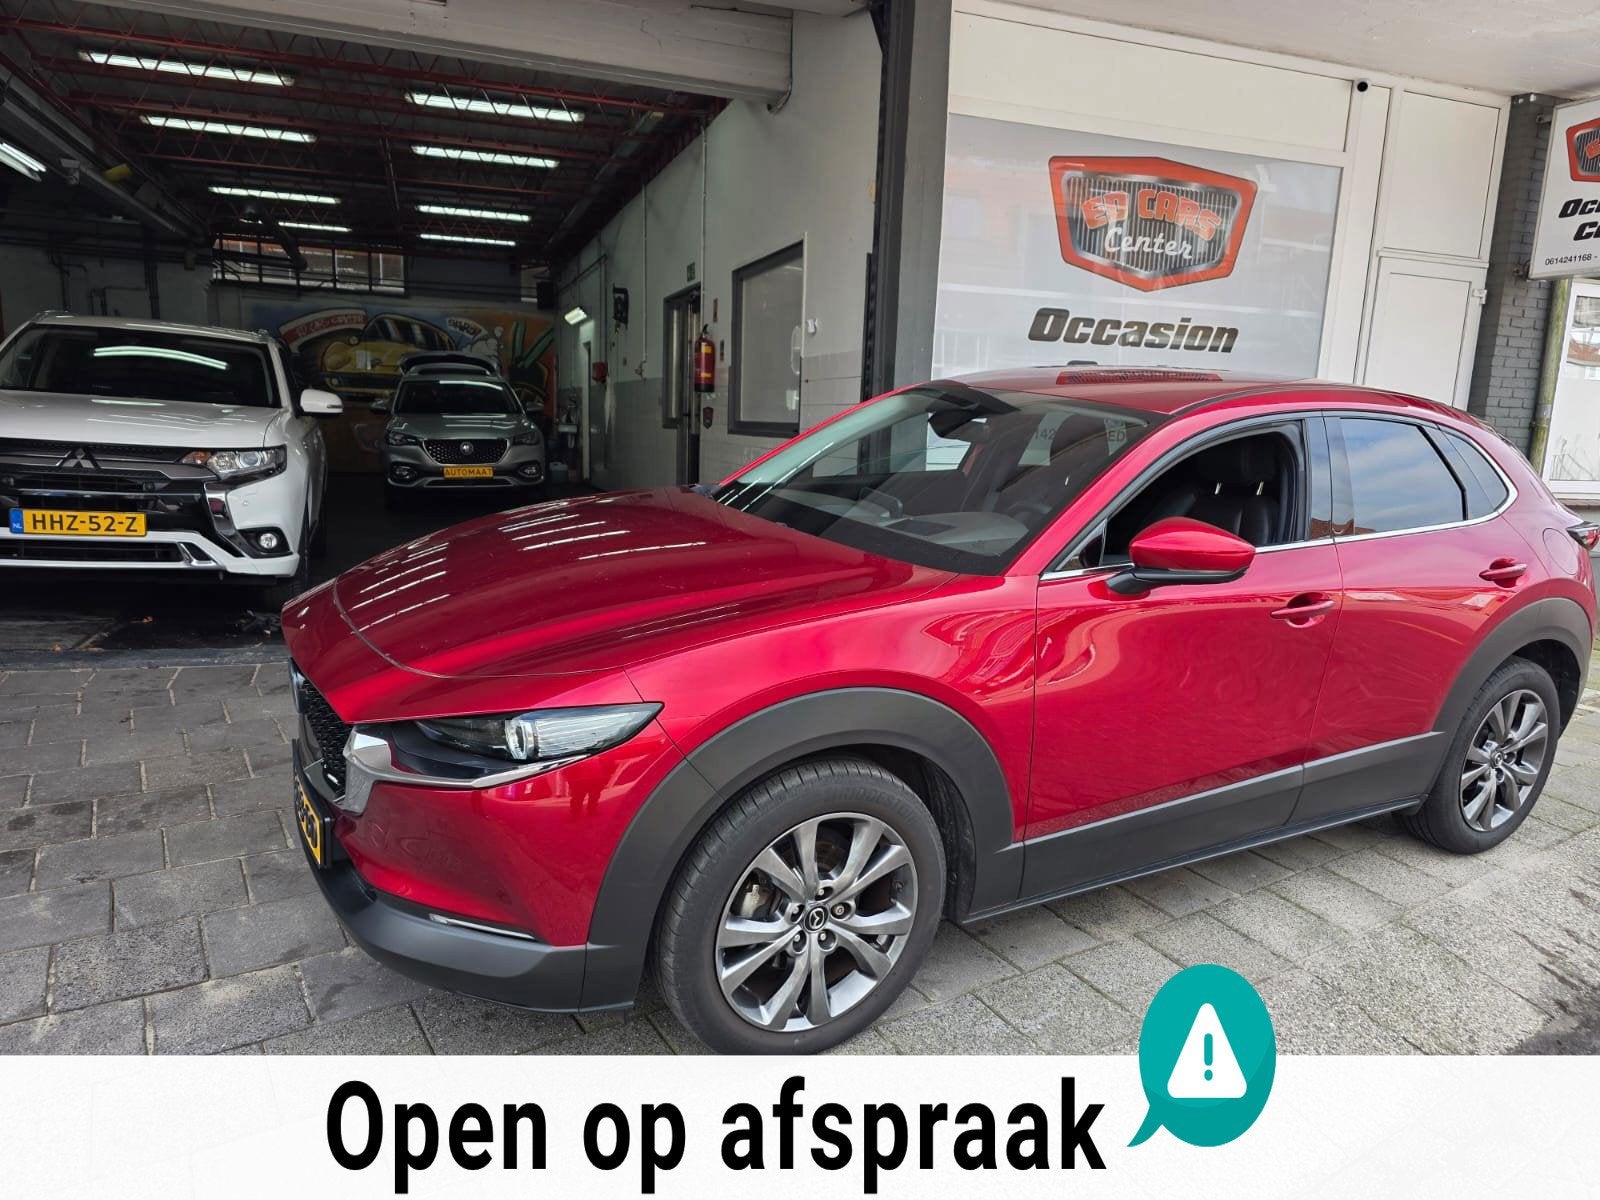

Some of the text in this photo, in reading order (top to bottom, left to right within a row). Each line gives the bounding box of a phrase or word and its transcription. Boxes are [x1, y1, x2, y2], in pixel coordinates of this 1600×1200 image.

[1082, 188, 1221, 241] ED CARS
[1558, 198, 1600, 218] Oc
[1104, 227, 1193, 260] Center
[1545, 253, 1592, 266] 0614241168
[1028, 307, 1239, 353] Occasion
[445, 468, 491, 476] AUTOMAAT
[32, 513, 138, 533] HHZ-52-Z
